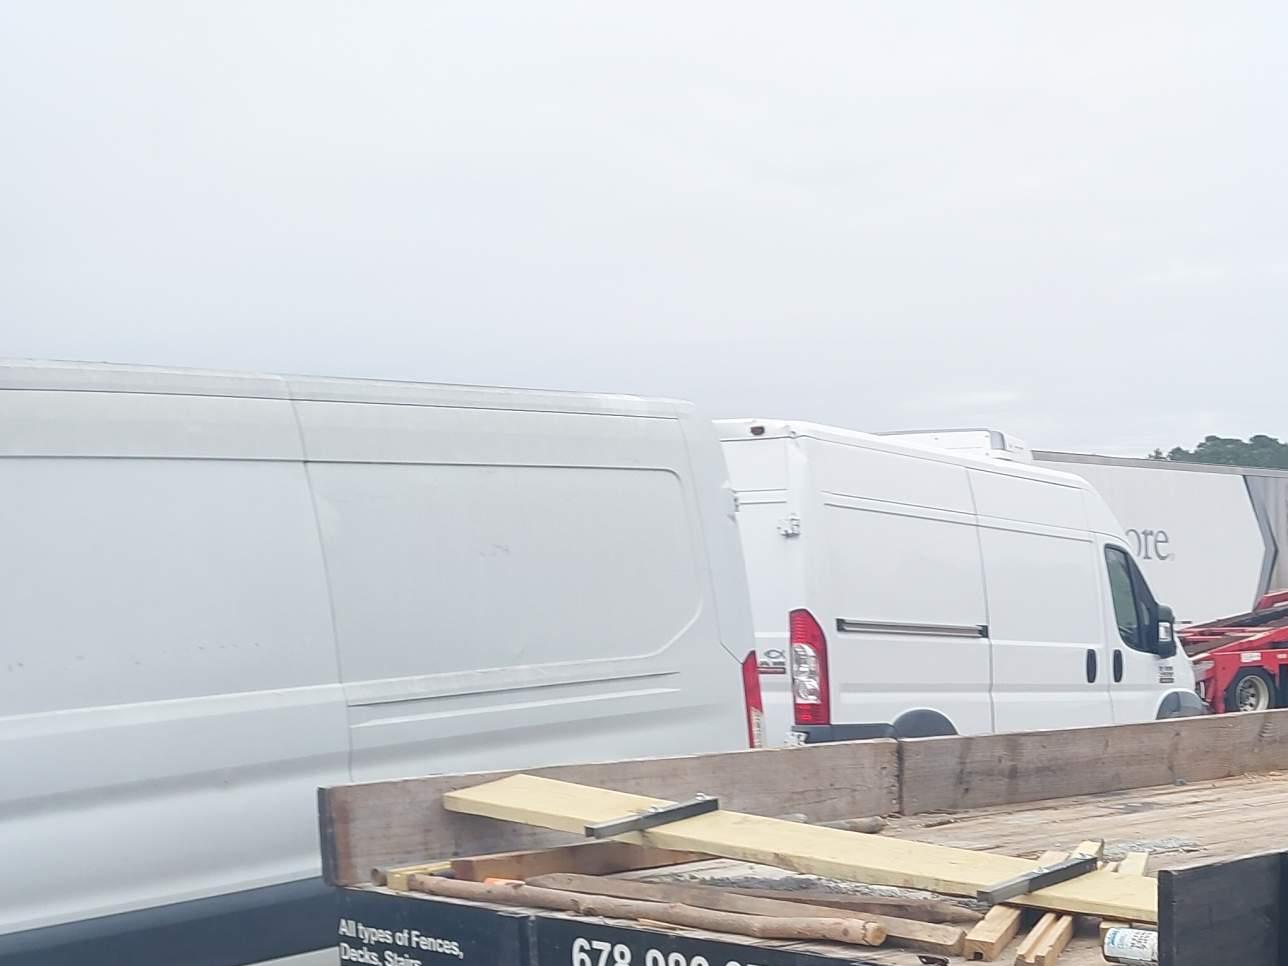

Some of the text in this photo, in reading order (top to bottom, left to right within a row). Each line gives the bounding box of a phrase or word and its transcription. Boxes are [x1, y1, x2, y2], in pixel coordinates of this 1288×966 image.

[338, 918, 464, 959] All types of Fences,
